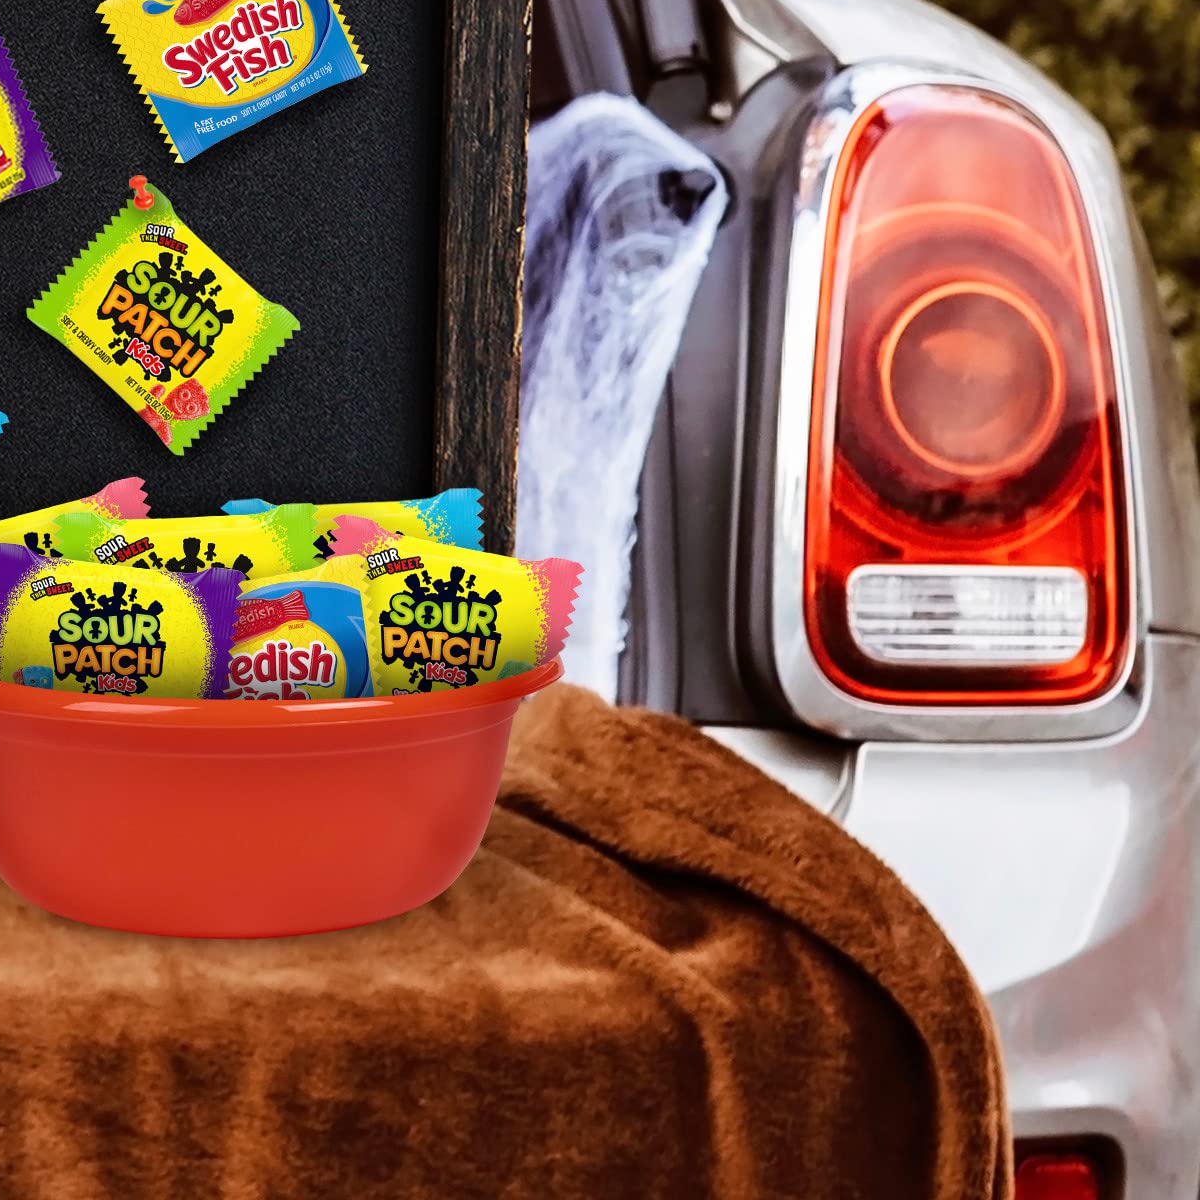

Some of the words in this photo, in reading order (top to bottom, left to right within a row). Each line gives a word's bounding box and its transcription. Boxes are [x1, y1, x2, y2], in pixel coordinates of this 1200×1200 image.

[206, 36, 289, 93] Fish
[196, 124, 216, 135] FREE
[216, 115, 238, 129] FOOD
[200, 117, 214, 126] FAT
[146, 224, 174, 239] SOUR
[126, 262, 221, 347] SOUR
[60, 315, 75, 329] SOFT
[76, 330, 97, 350] CHEWY
[93, 346, 113, 365] CANDY
[101, 284, 208, 376] PATCH
[125, 337, 165, 376] Kids
[135, 385, 147, 396] WT
[95, 536, 128, 561] SOUR
[117, 538, 154, 562] SWEET.
[367, 548, 399, 568] SOUR
[368, 567, 386, 579] THEN
[386, 557, 424, 574] SWEET.
[31, 577, 55, 592] SOUR
[238, 605, 275, 625] edish
[389, 593, 495, 637] SOUR
[58, 612, 159, 646] SOUR
[383, 626, 496, 669] PATCH
[52, 644, 164, 676] PATCH
[230, 642, 333, 686] edish
[96, 674, 137, 692] Kids
[425, 661, 468, 684] Kids
